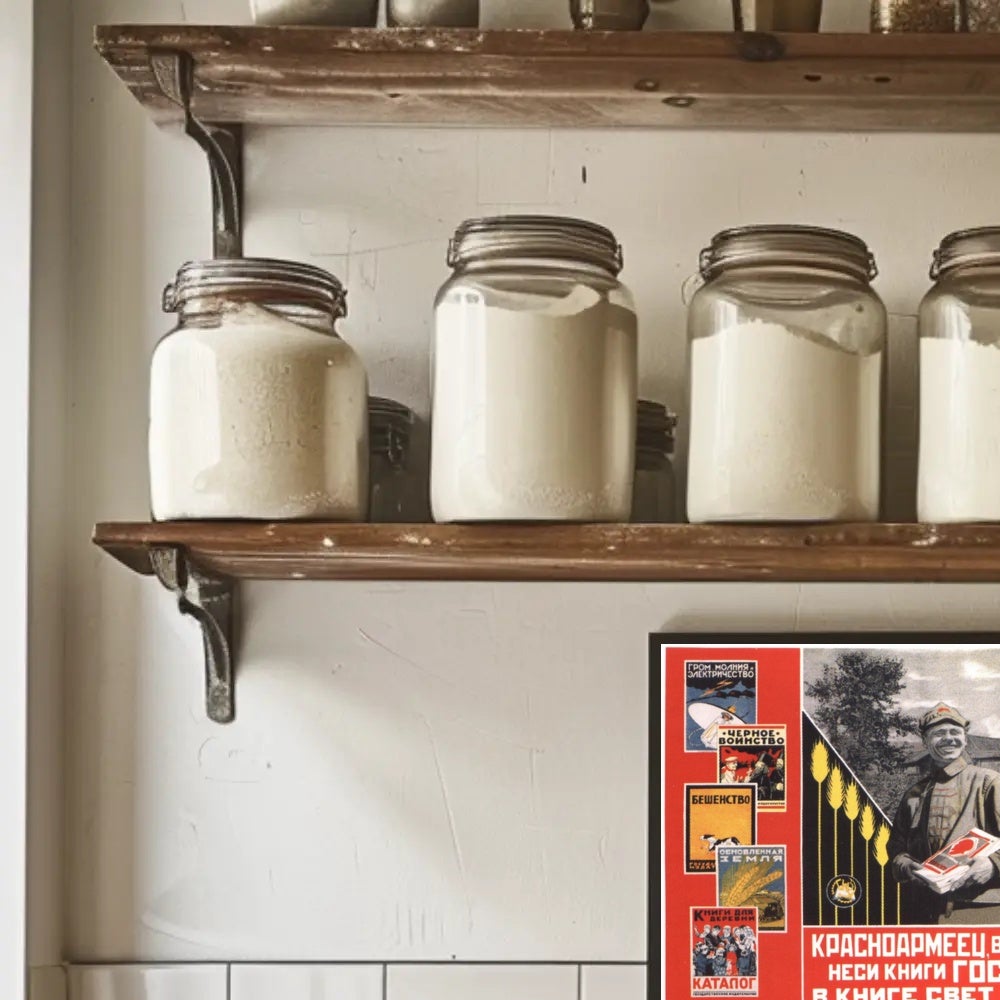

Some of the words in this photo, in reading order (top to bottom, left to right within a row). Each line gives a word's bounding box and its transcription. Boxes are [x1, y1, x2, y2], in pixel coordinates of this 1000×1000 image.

[692, 795, 750, 804] БЕШЕНСТВО
[812, 933, 990, 958] КРАСНОАРМЕЕЦ,
[828, 964, 879, 981] НЕСИ
[884, 963, 946, 980] КНИГИ
[692, 978, 756, 989] КАТАЛОГ
